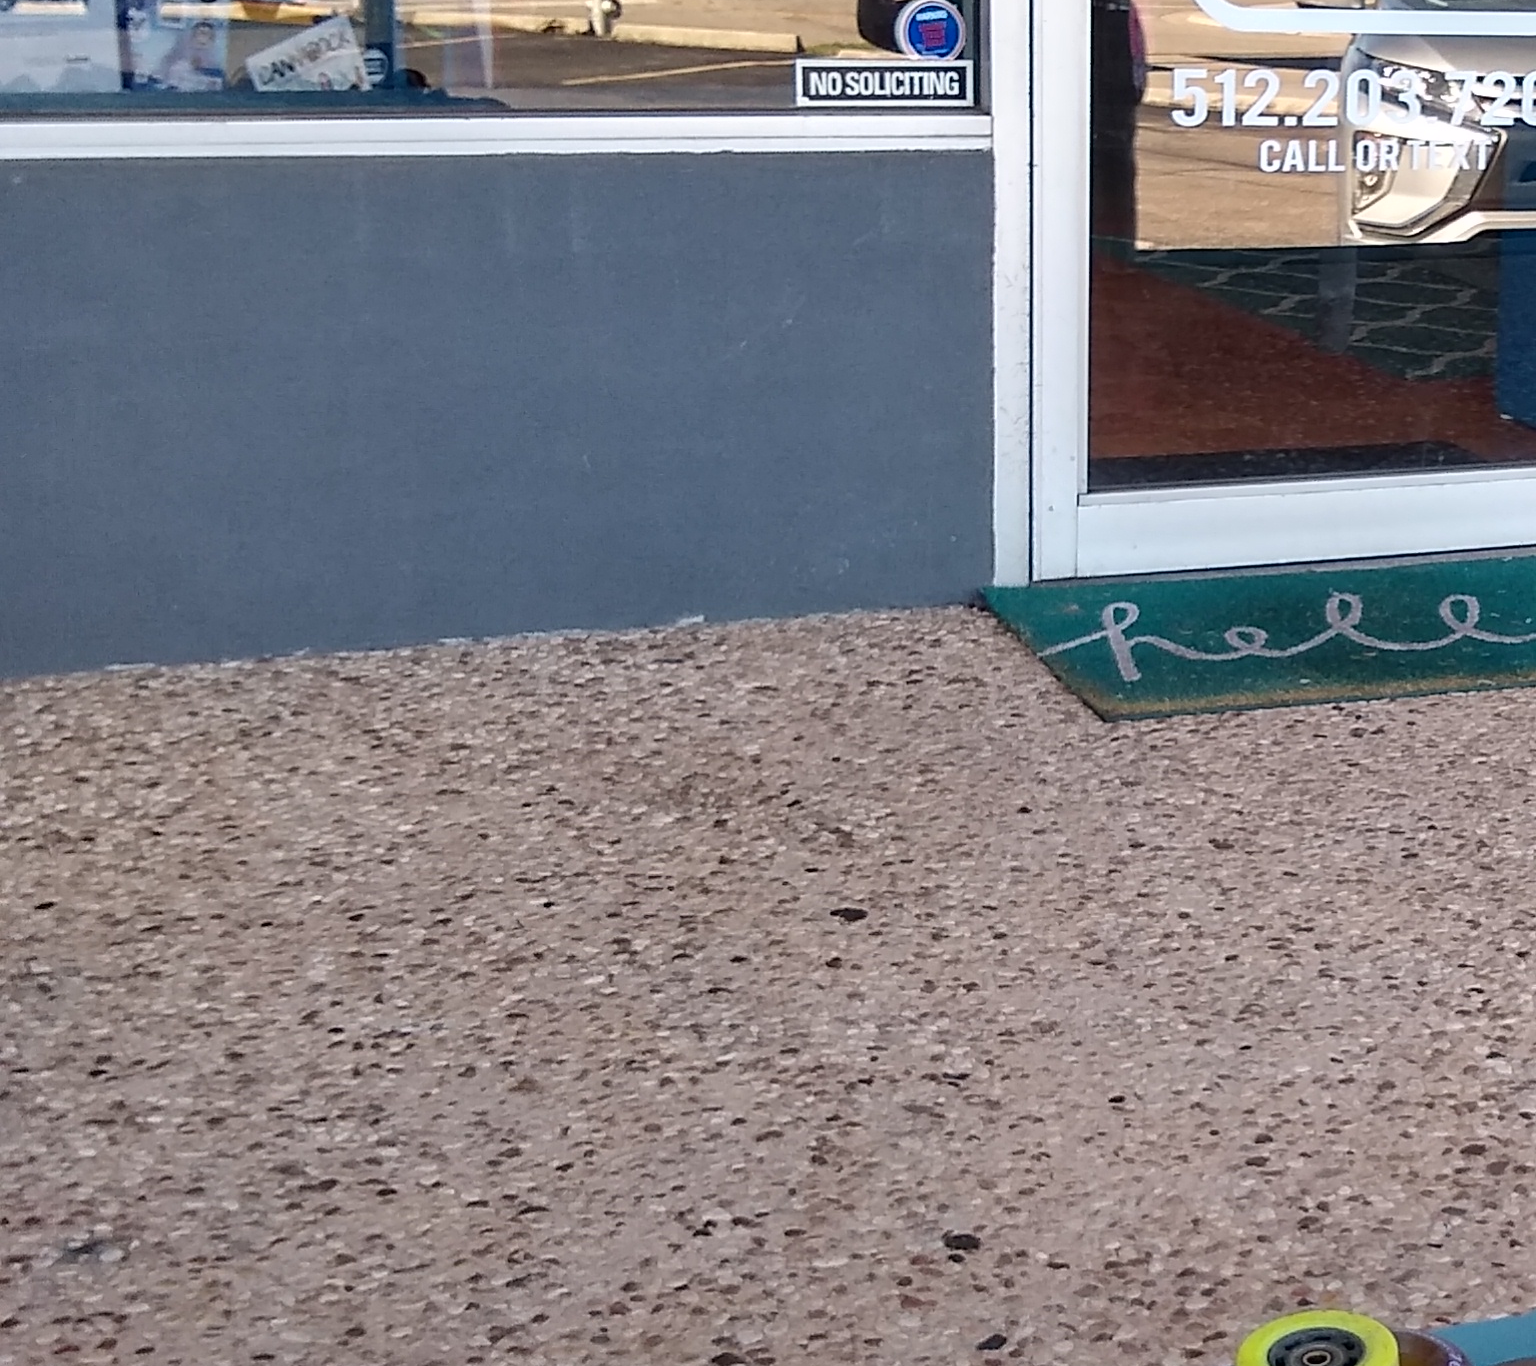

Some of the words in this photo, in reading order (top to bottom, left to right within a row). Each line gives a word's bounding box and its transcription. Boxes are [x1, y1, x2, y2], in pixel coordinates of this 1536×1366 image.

[809, 72, 843, 96] NO
[846, 71, 960, 97] SOLICITING
[1258, 138, 1347, 173] CALL
[1354, 139, 1402, 172] OR
[1404, 138, 1493, 172] TEXT
